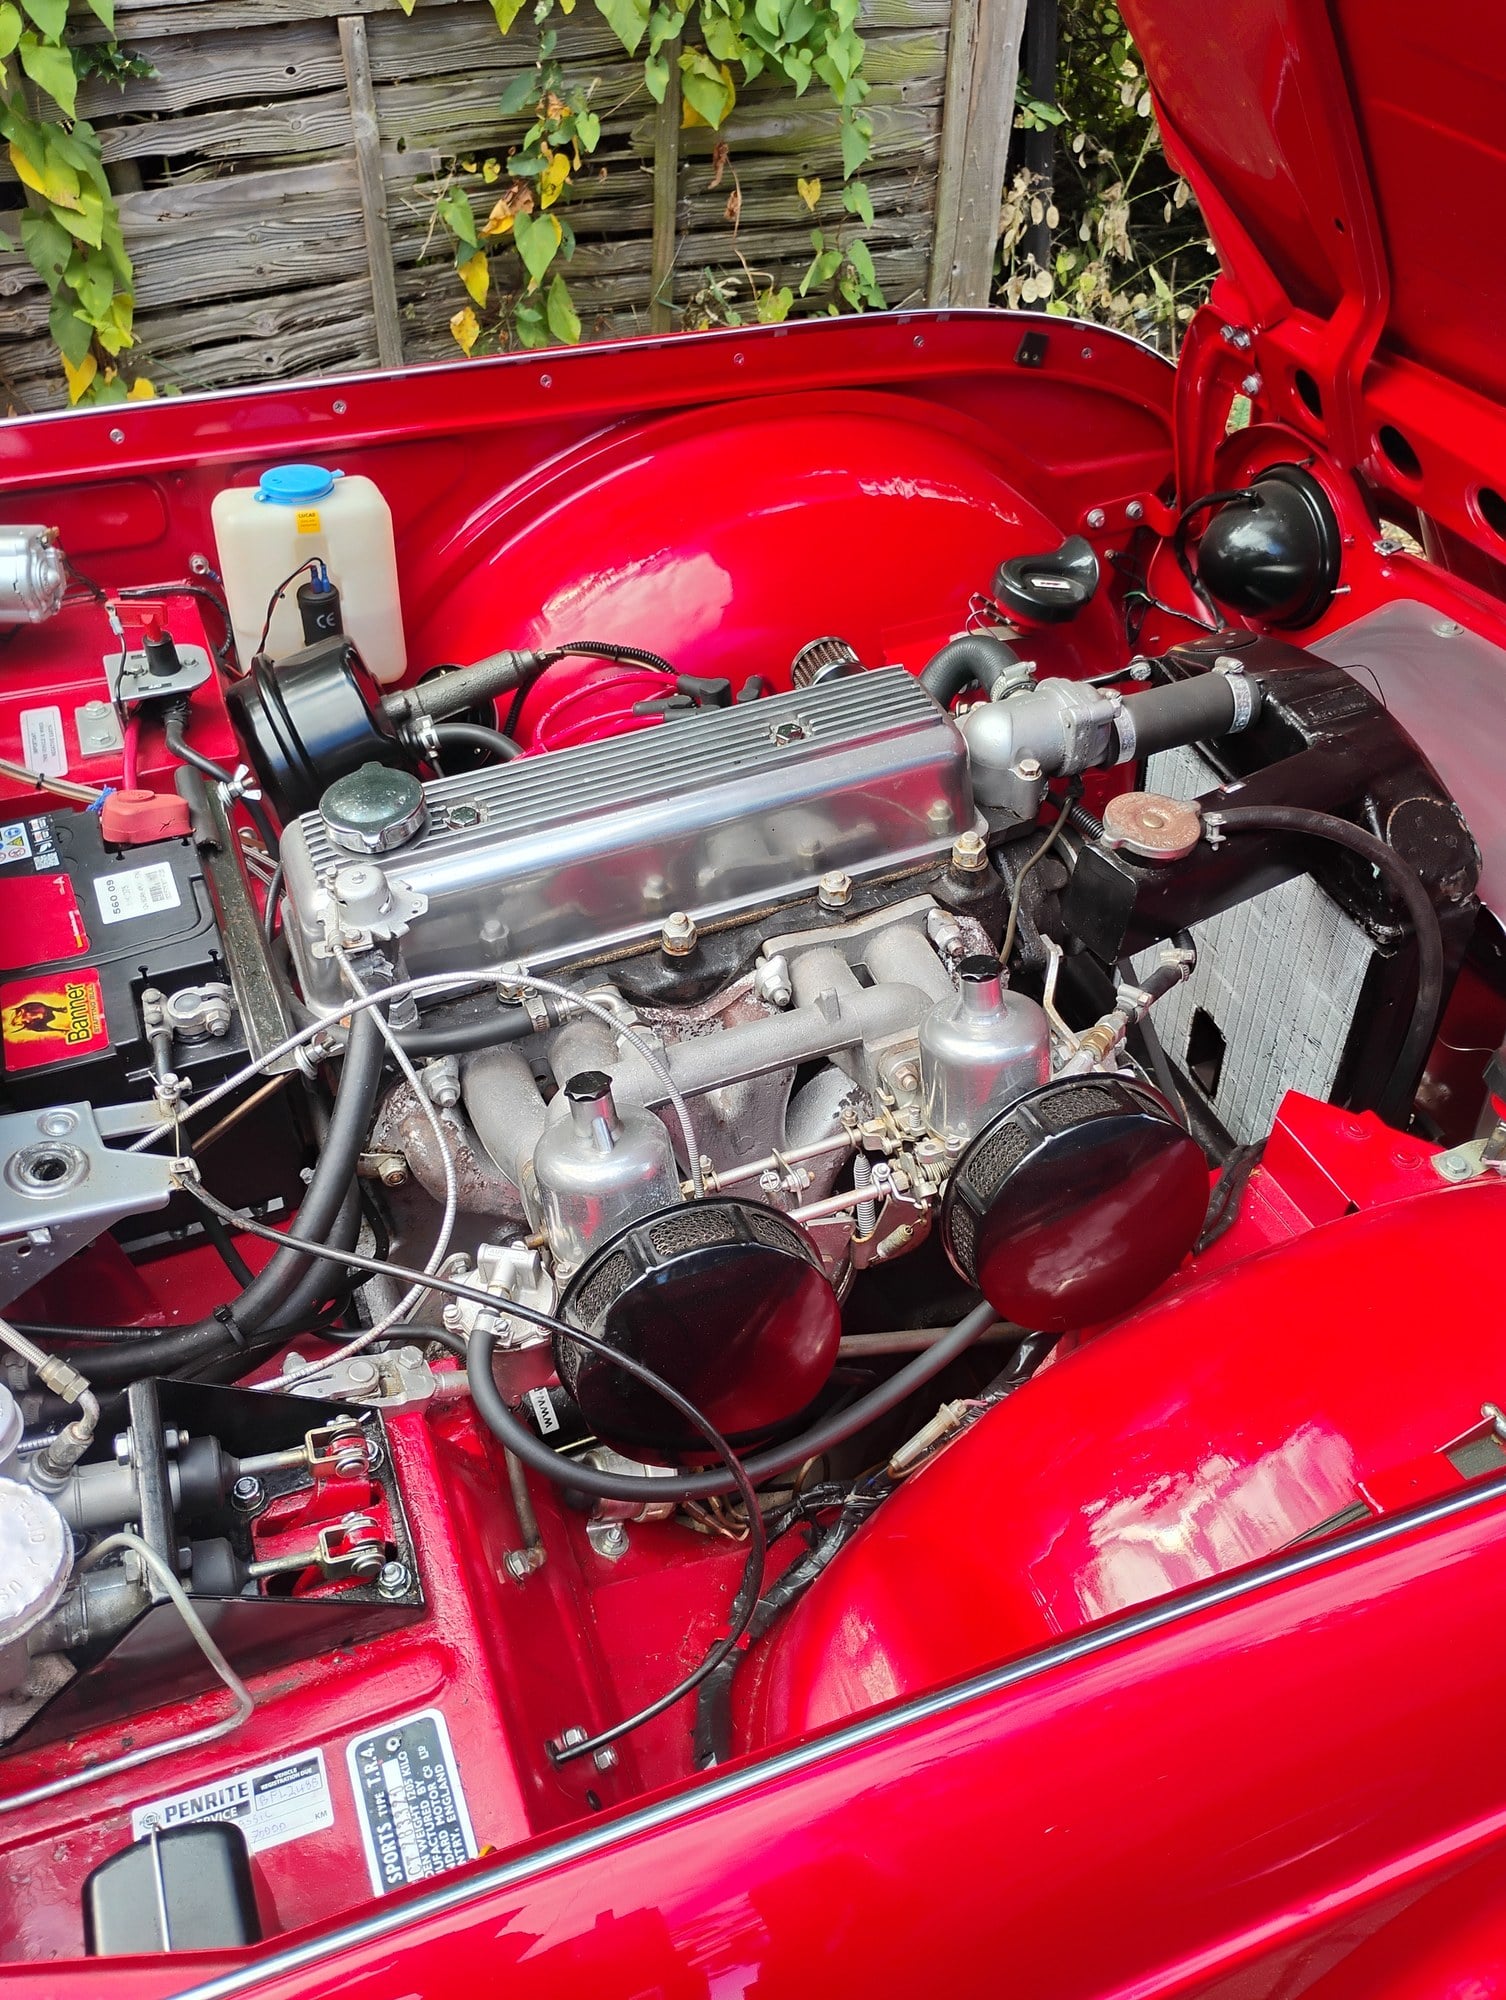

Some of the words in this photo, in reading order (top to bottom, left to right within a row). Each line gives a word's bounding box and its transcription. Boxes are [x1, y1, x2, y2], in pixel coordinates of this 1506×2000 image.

[316, 612, 336, 628] CE
[106, 880, 116, 892] 09
[110, 895, 121, 914] 560
[67, 984, 91, 1043] Banner
[360, 1742, 382, 1788] T.R.4.
[398, 1750, 412, 1776] KILO
[164, 1782, 250, 1823] PENRITE
[374, 1790, 388, 1818] TYPE
[415, 1780, 426, 1796] BY
[427, 1782, 446, 1826] MOTOR
[434, 1764, 457, 1824] ENGLAND
[193, 1806, 238, 1823] RVICE
[314, 1810, 328, 1820] KM
[410, 1804, 428, 1852] WEIGHT
[377, 1822, 403, 1884] SPORTS
[420, 1800, 445, 1874] UFACTURED
[438, 1830, 456, 1869] NDARD
[450, 1828, 467, 1866] NTRY,
[421, 1854, 435, 1878] DEN
